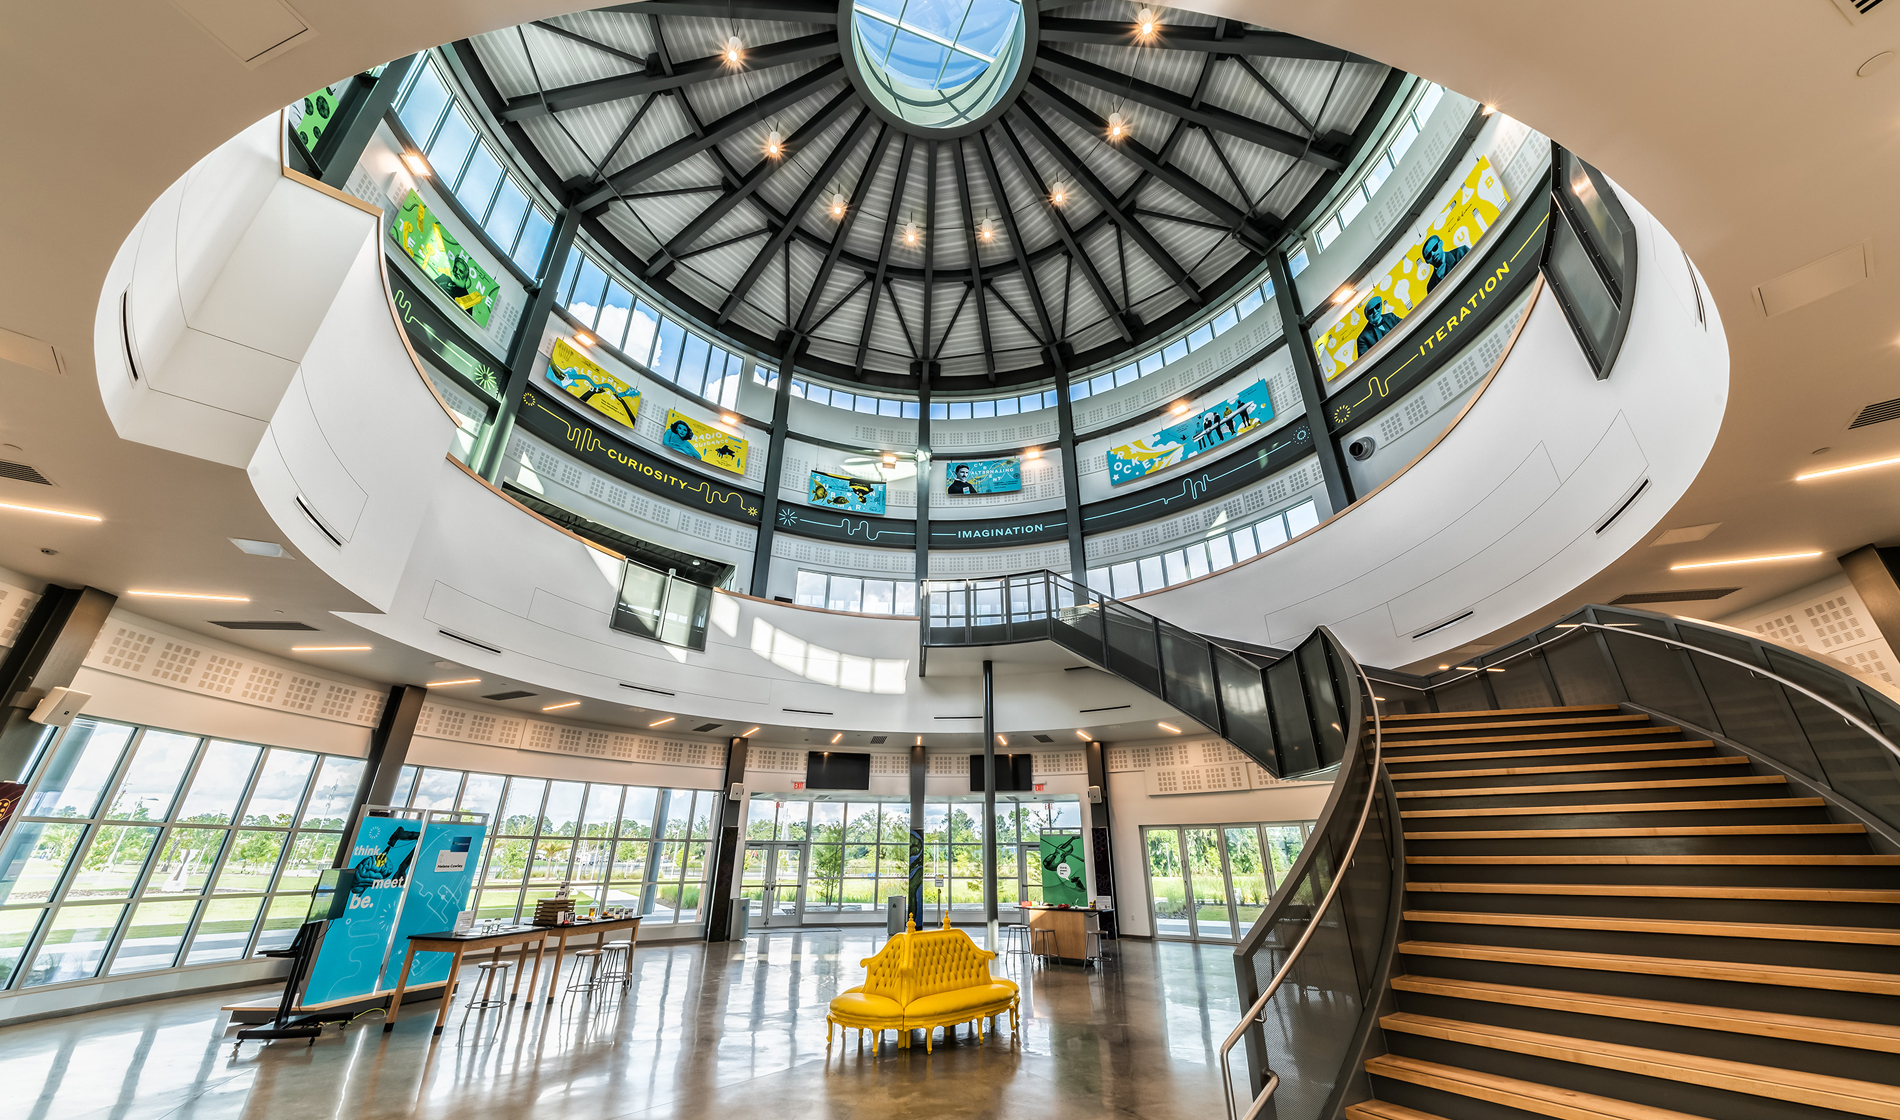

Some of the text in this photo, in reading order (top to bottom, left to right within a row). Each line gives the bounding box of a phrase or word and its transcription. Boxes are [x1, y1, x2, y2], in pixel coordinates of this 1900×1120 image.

[1419, 261, 1510, 356] ITERATION
[573, 366, 623, 393] ELECTRIC
[692, 432, 722, 442] RADIO
[607, 449, 688, 489] CURIOSITY
[1113, 451, 1161, 474] ROCKET
[958, 524, 1043, 538] IMAGINATION
[354, 845, 381, 856] think.
[349, 893, 373, 910] be.
